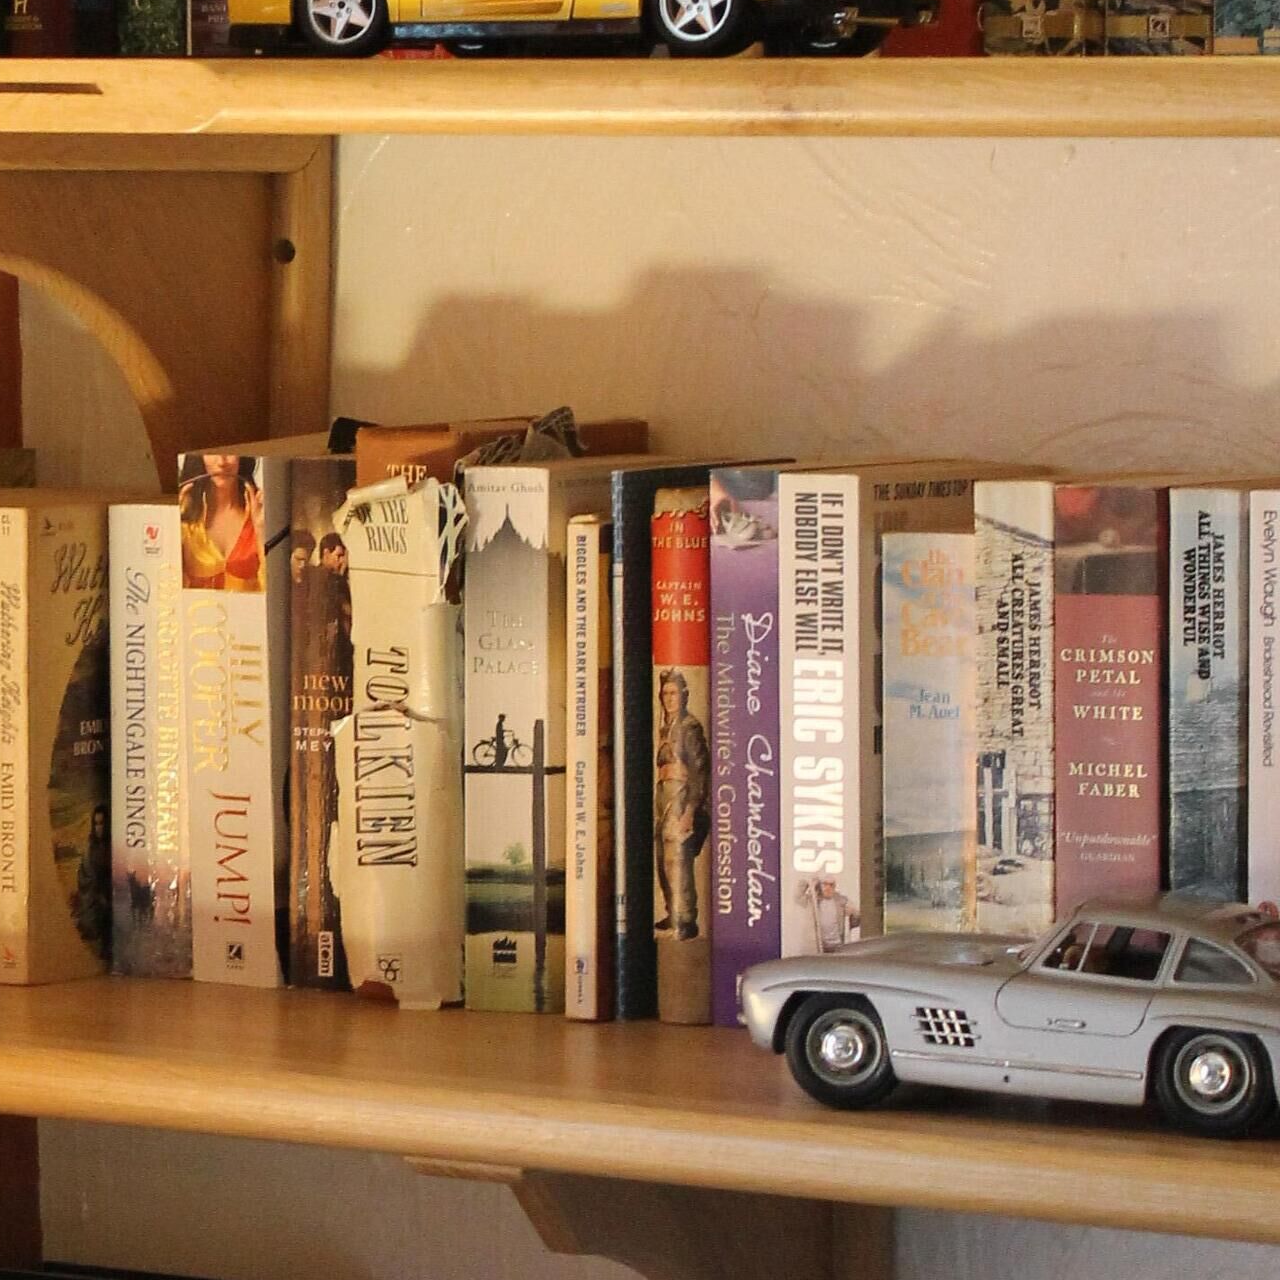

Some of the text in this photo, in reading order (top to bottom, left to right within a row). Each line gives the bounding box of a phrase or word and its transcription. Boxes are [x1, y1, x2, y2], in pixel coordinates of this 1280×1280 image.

[380, 499, 409, 525] THE
[821, 493, 844, 508] IF
[874, 484, 891, 501] THE
[365, 526, 408, 554] RINGS
[652, 536, 708, 549] THE BLUE
[821, 525, 844, 575] DON'T
[656, 580, 702, 591] CAPTAIN
[795, 493, 818, 652] NOBODY ELSE WILL
[1260, 510, 1278, 627] Evelyn Waugh
[653, 608, 705, 623] JOHNS
[821, 580, 844, 632] WRITE
[1183, 547, 1197, 648] WONDERFUL
[1198, 509, 1211, 681] ALL THINGS WISE AND
[1212, 531, 1226, 661] JAMES HERRIOT
[996, 600, 1010, 689] AND SMALL
[1011, 553, 1024, 737] ALL CREATURES GREAT
[1025, 578, 1042, 710] JAMES HERRIOT
[1060, 648, 1155, 665] CRIMSON
[303, 673, 349, 692] new
[1076, 669, 1142, 685] PETAL
[125, 566, 152, 849] The NIGHTINGALE SINGS
[575, 535, 586, 880] BIGGLES AND THE DARK INTRUDER Captain Johns
[1073, 704, 1144, 720] WHITE
[353, 646, 418, 867] TOLKIEN
[716, 612, 738, 915] The Midwife's Confession
[741, 611, 775, 927] Diane Chamberlain
[793, 658, 844, 874] ERIC SYKES
[1068, 763, 1148, 779] MICHEL
[1, 762, 14, 811] EMILY
[157, 727, 180, 853] BINGHAM
[1077, 782, 1142, 799] FABER
[207, 789, 253, 927] JUMP!
[319, 934, 332, 975] atom
